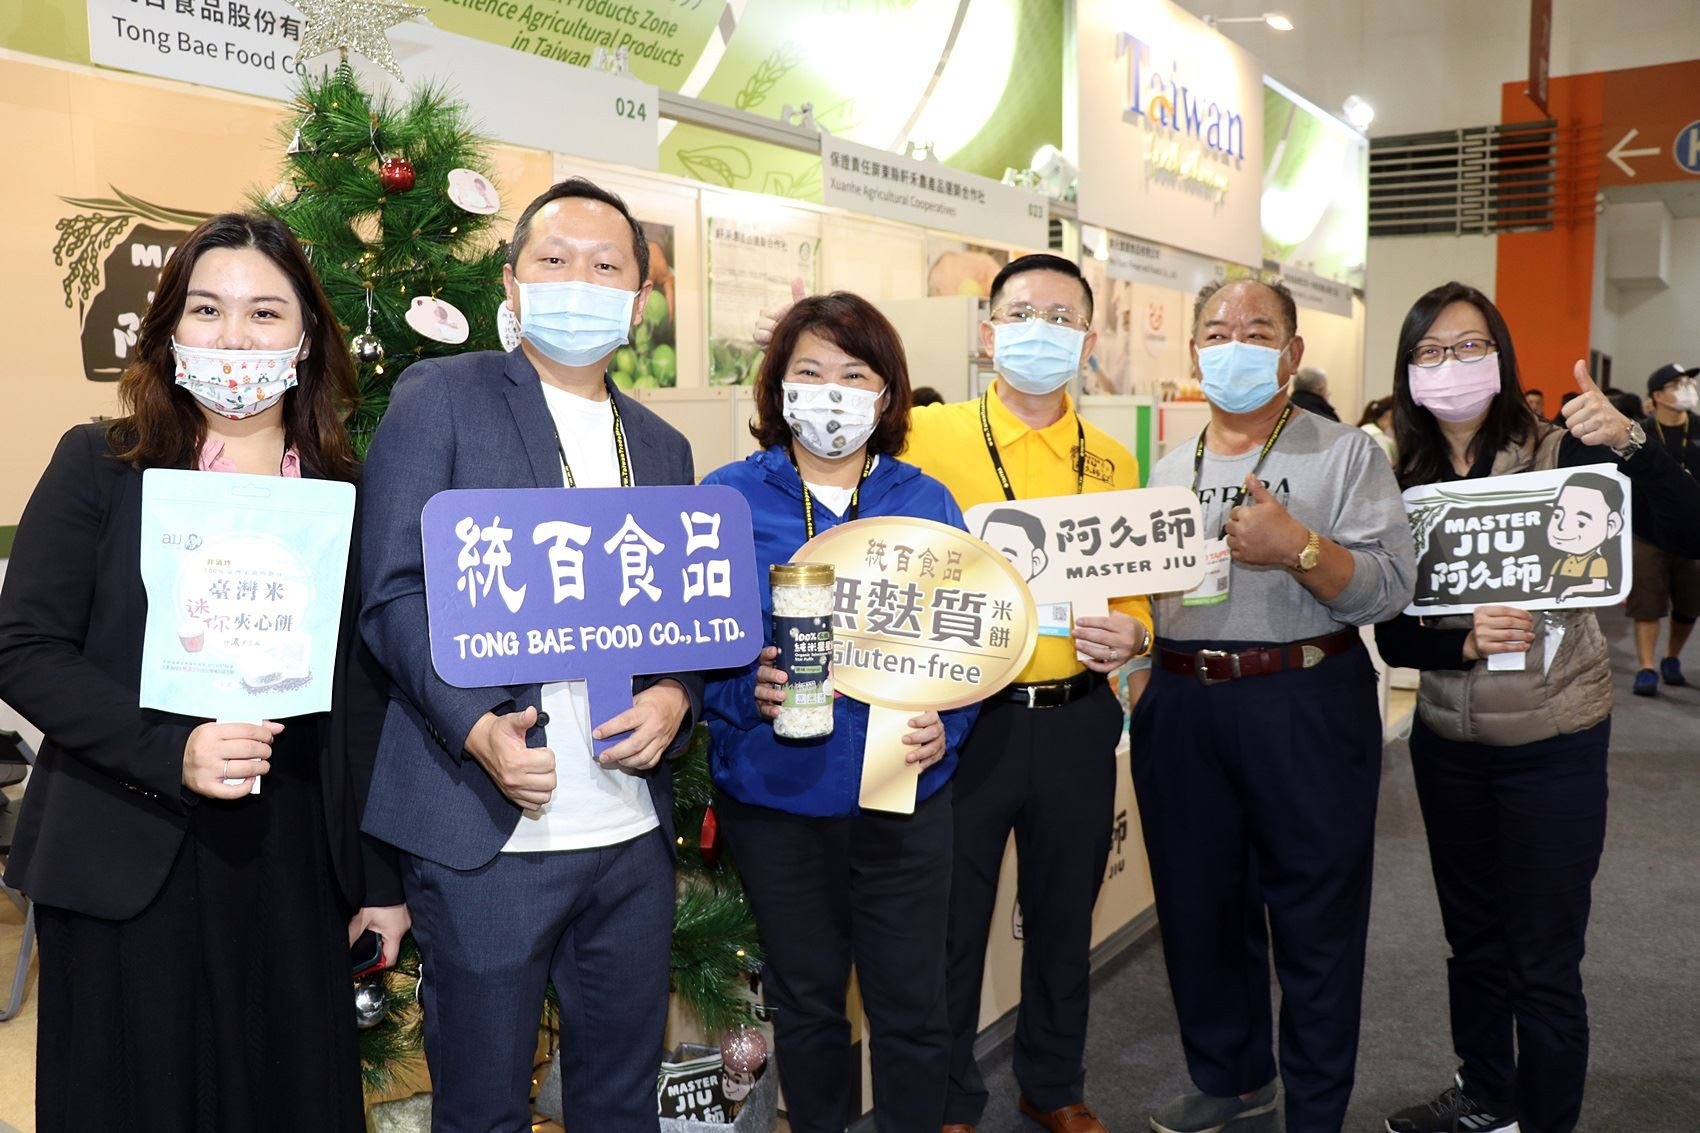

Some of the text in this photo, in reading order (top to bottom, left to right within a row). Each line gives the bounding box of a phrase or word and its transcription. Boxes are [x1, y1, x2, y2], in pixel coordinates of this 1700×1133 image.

[131, 0, 305, 42] 食品股份有
[518, 4, 619, 49] Agricultural
[620, 32, 685, 68] Products
[566, 0, 678, 37] roducts Zone
[112, 15, 171, 54] Tong
[177, 32, 218, 59] Bae
[225, 42, 276, 71] Food
[511, 30, 592, 68] in Taiwan
[615, 97, 647, 122] 024
[1115, 31, 1244, 161] Taiwan
[829, 177, 861, 196] Xuanhe
[863, 186, 910, 206] Agricultural
[1056, 506, 1196, 556] 阿久師
[1444, 510, 1541, 534] MASTER
[455, 511, 731, 613] 統百食品
[864, 538, 962, 582] 統百食品
[1453, 530, 1525, 557] JIU
[1066, 559, 1152, 580] MASTER
[1163, 555, 1197, 571] JIU
[1430, 554, 1542, 595] 阿久師
[208, 578, 285, 602] 臺灣米
[454, 631, 519, 659] TONG
[527, 627, 576, 654] BAE
[580, 623, 643, 651] FOOD
[795, 632, 816, 641] 100%
[989, 600, 1013, 649] 米餅
[667, 1075, 719, 1097] MASTER
[675, 1089, 713, 1113] JIU
